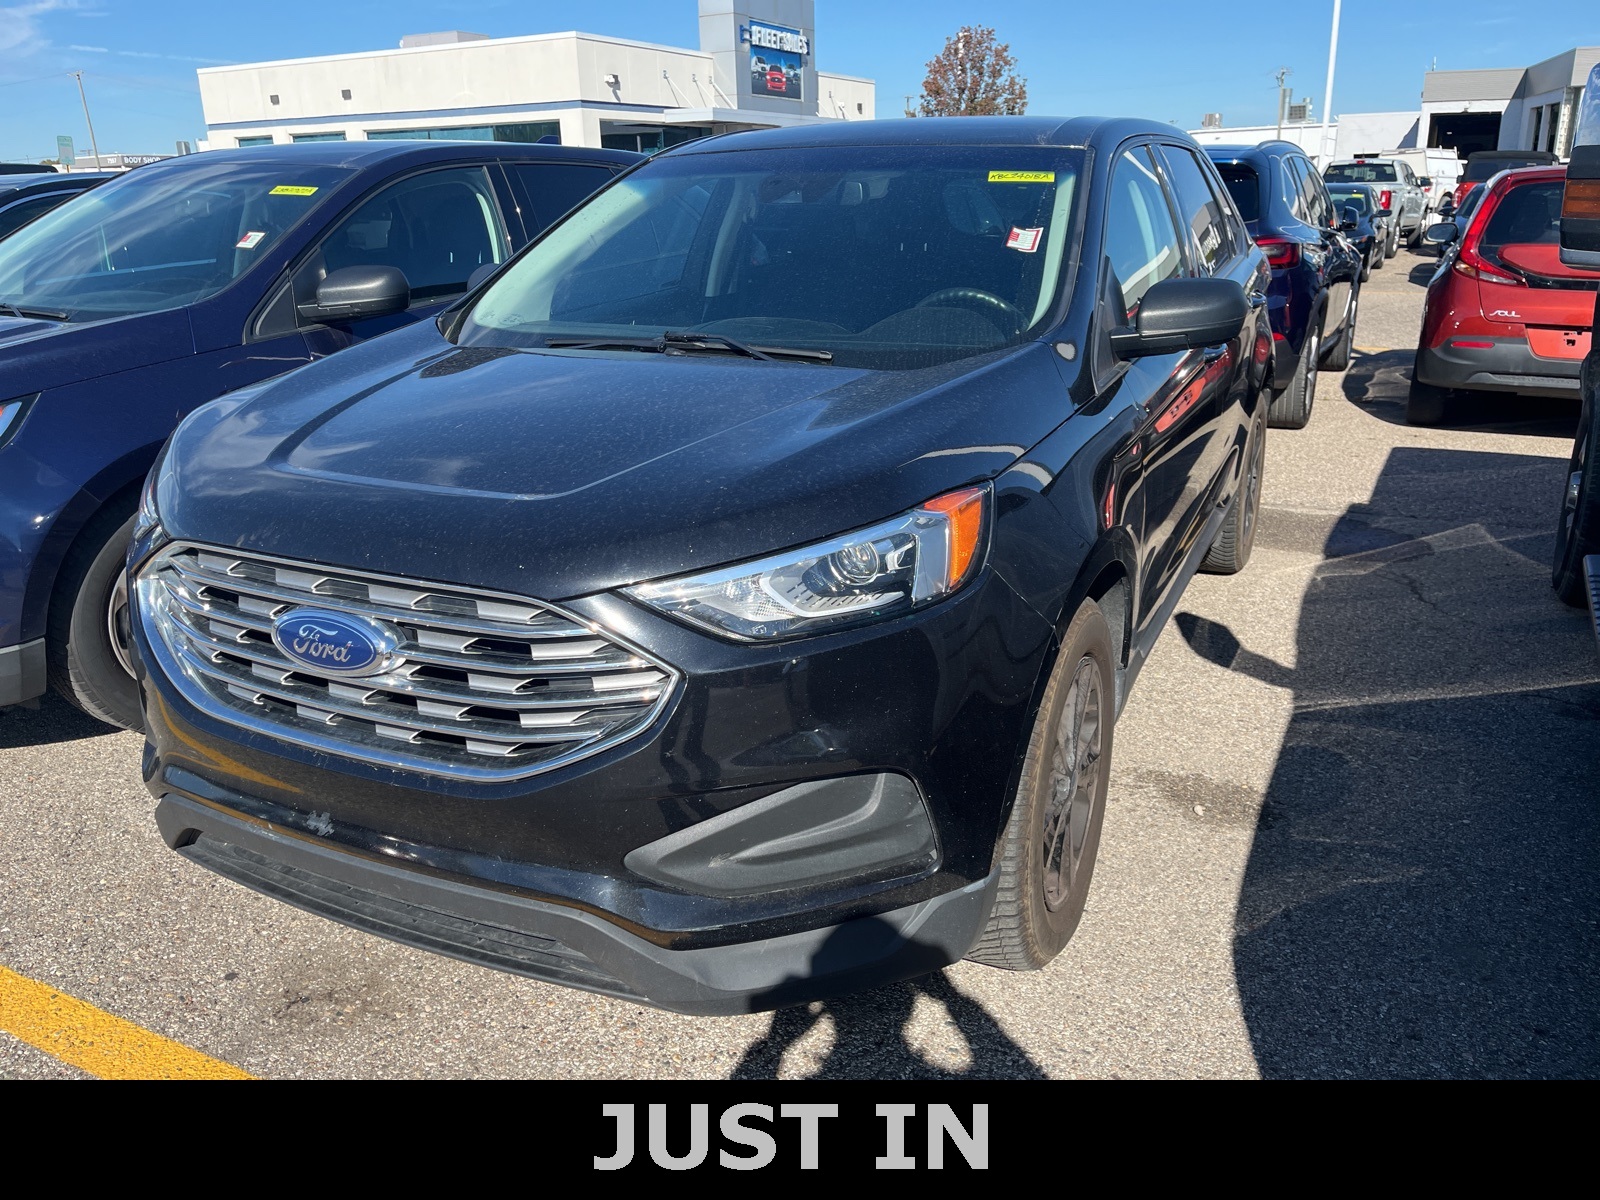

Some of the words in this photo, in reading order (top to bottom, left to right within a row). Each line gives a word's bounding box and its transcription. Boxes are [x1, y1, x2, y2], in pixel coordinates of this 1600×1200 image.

[752, 25, 781, 50] FLEET
[782, 32, 808, 54] SALES
[293, 624, 353, 662] Ford
